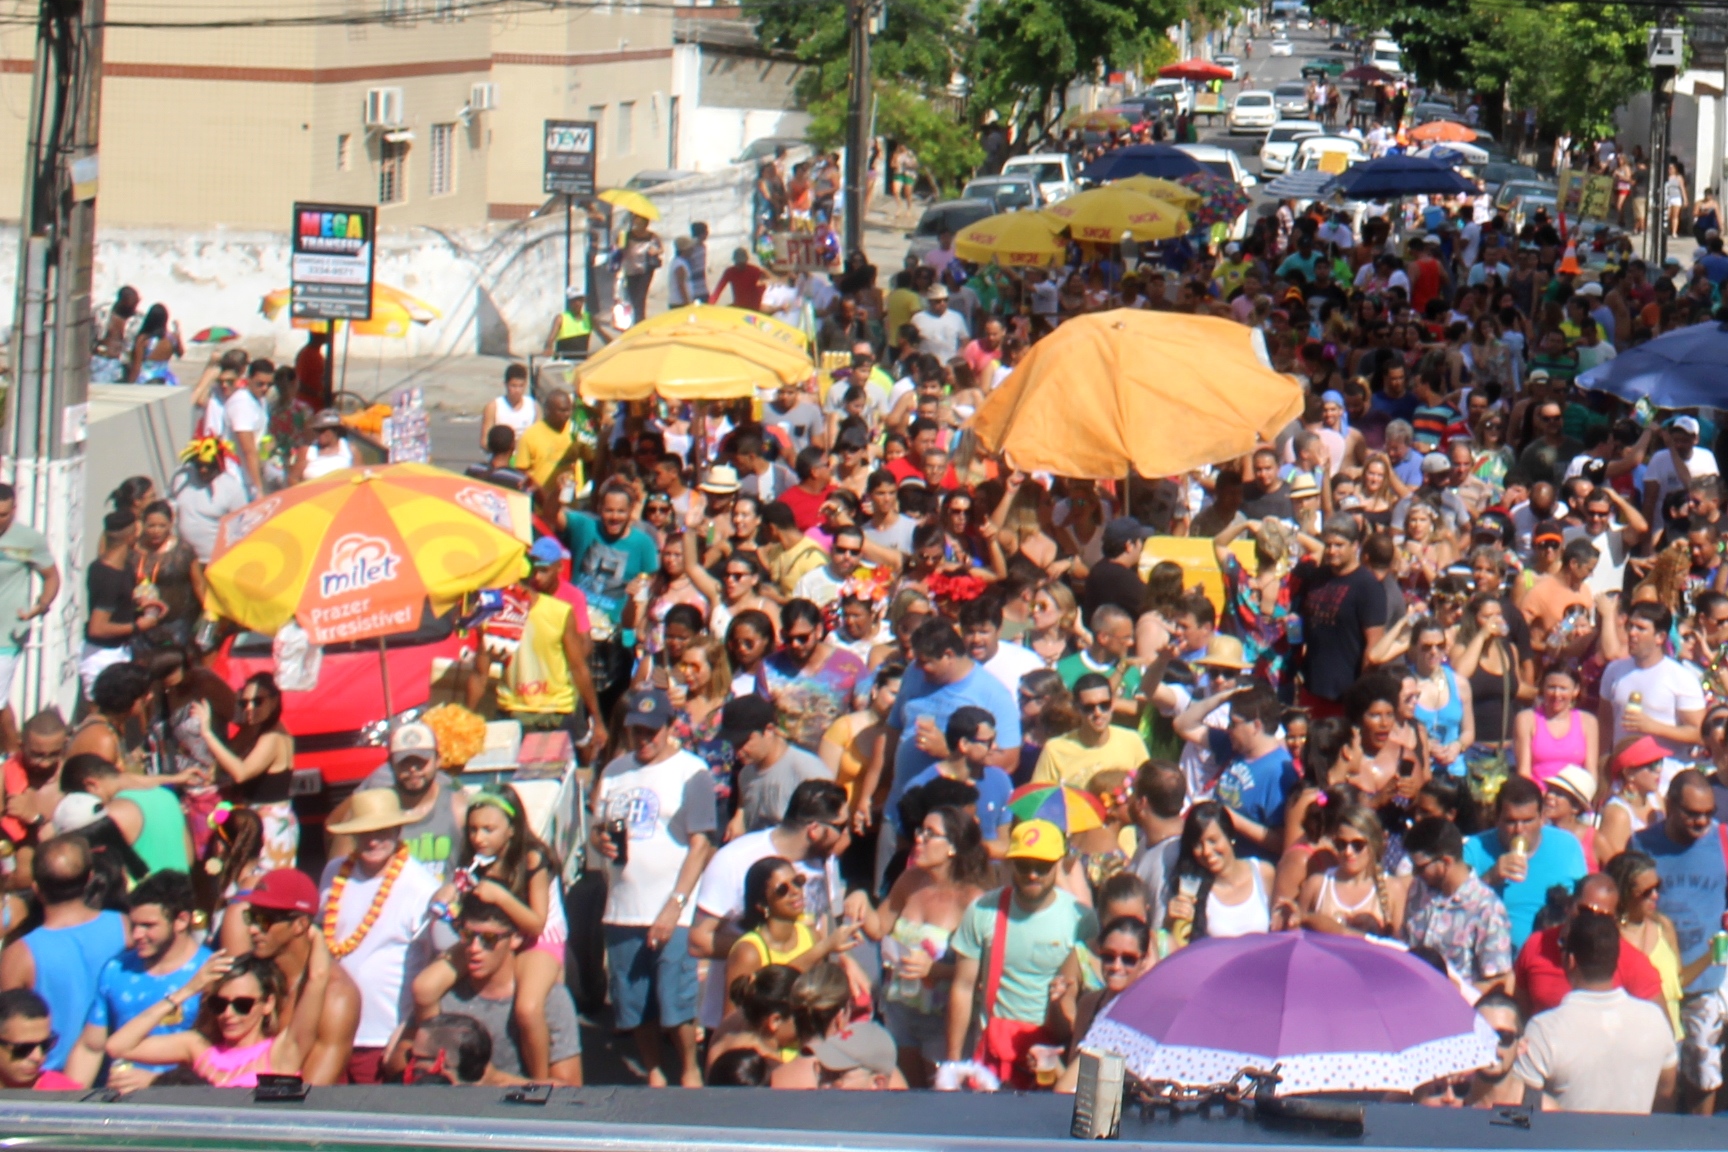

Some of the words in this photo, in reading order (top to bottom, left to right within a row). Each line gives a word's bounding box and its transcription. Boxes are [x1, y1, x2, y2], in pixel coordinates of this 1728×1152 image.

[300, 212, 363, 239] MEGA
[300, 236, 363, 252] TRANSFER
[322, 556, 396, 595] milet
[311, 598, 371, 624] Prazer
